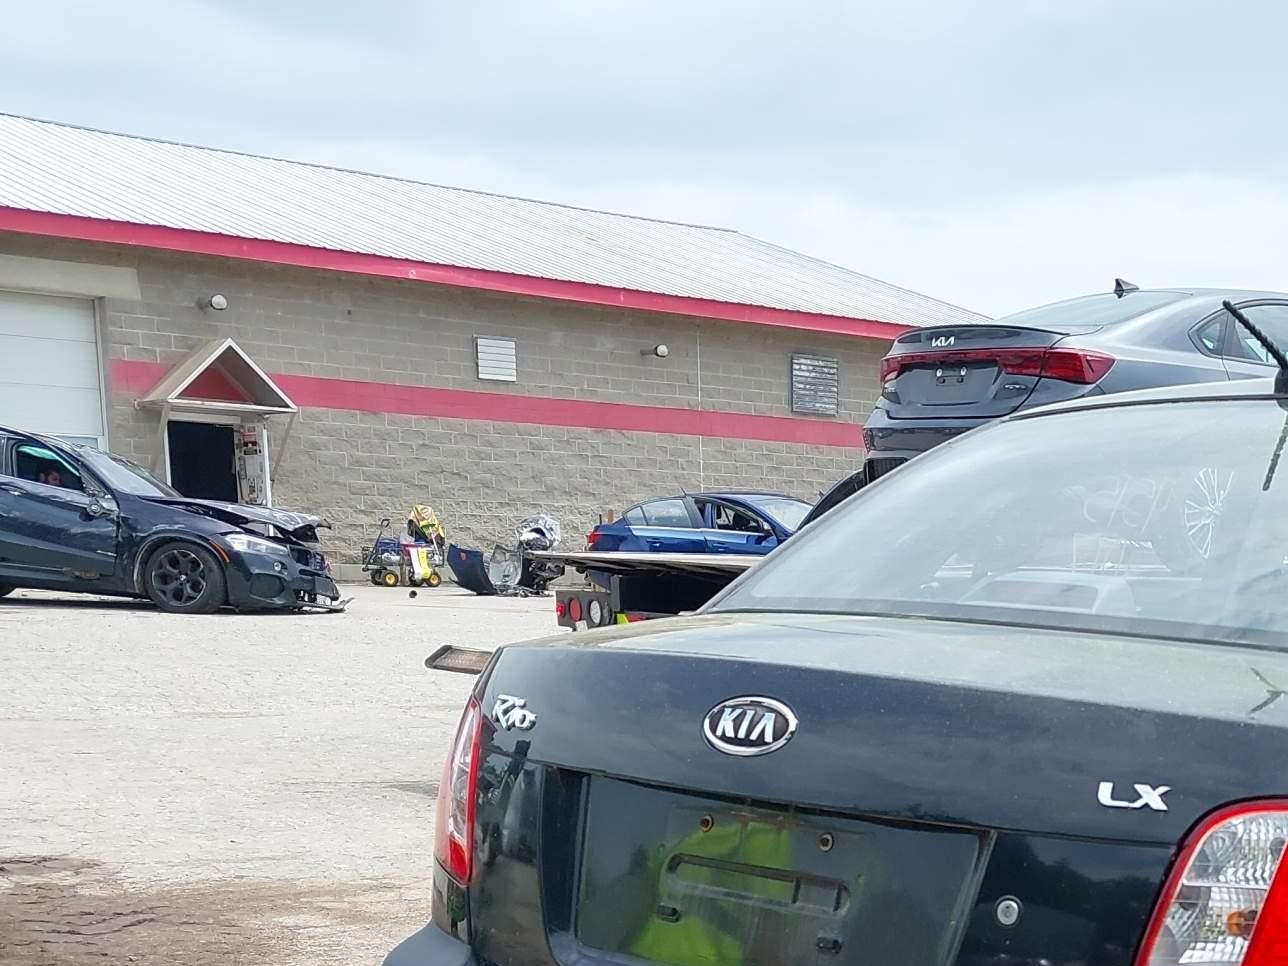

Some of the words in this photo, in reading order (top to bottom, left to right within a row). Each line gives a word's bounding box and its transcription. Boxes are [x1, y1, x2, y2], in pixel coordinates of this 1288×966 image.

[931, 335, 955, 348] KIA
[492, 693, 537, 730] Rio
[715, 707, 776, 744] KIA
[1096, 781, 1172, 812] LX
